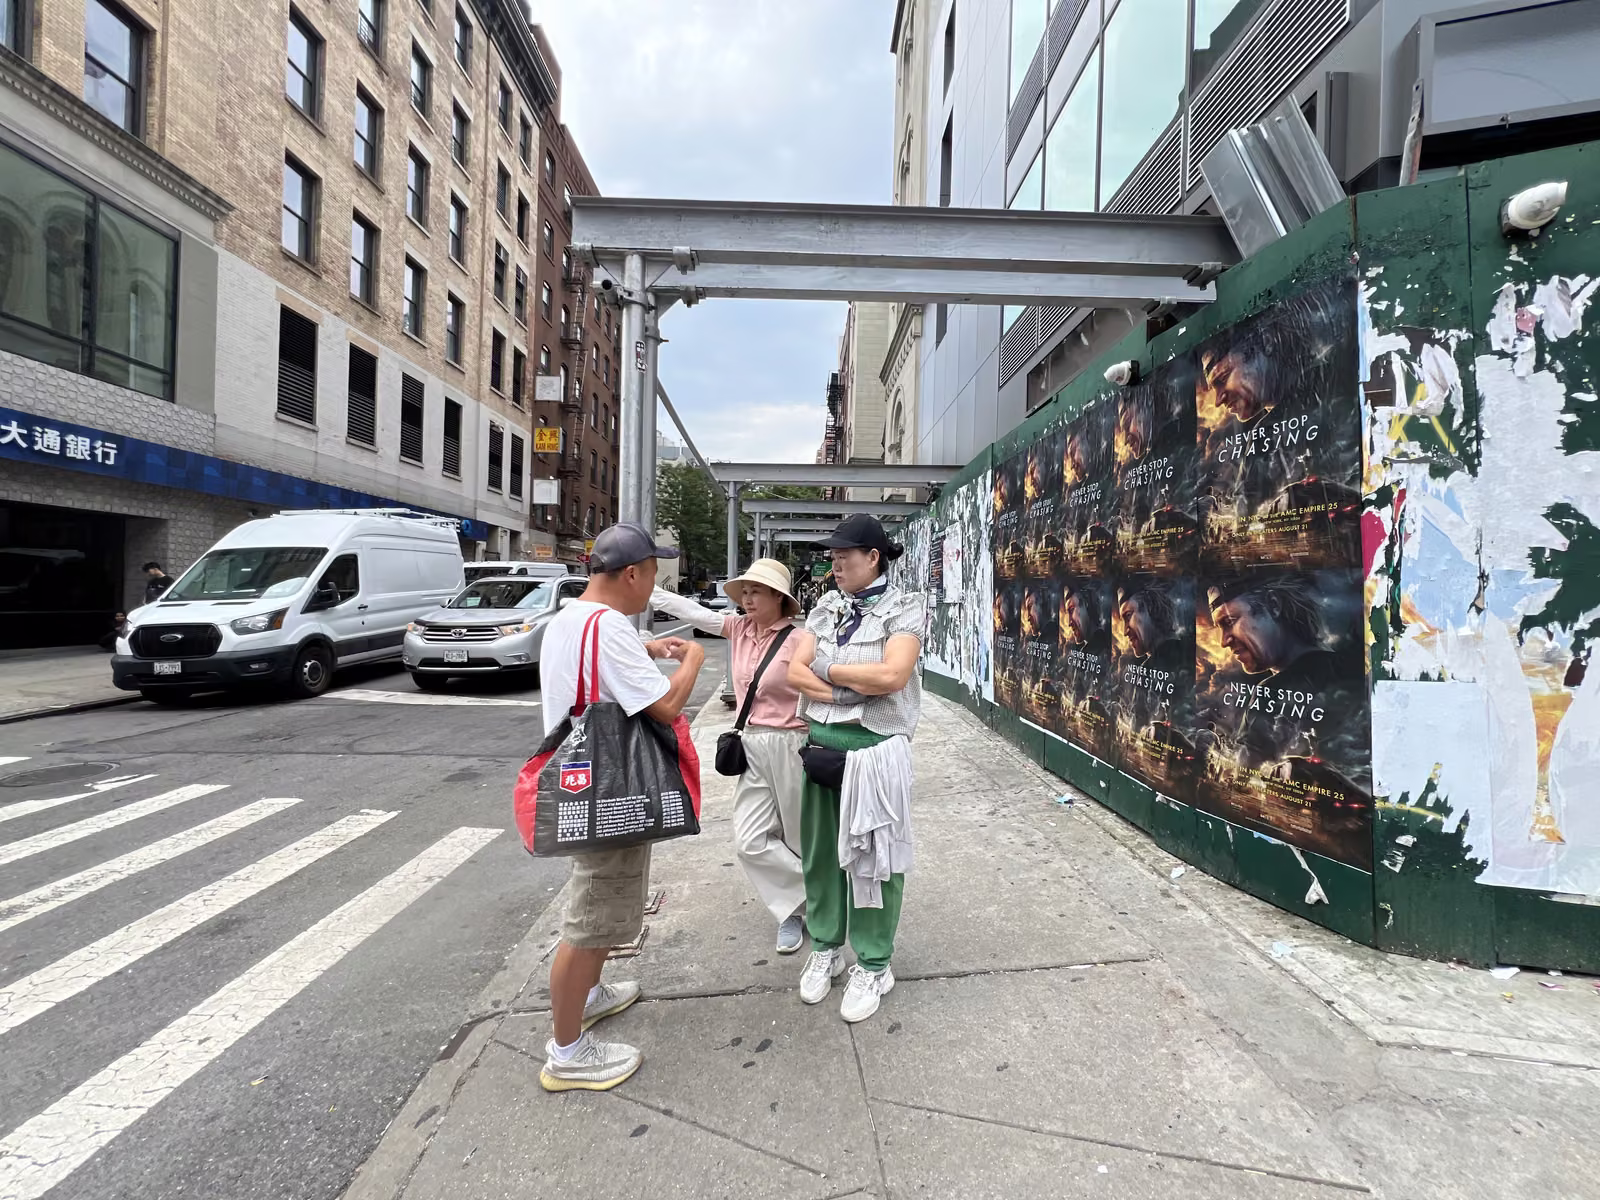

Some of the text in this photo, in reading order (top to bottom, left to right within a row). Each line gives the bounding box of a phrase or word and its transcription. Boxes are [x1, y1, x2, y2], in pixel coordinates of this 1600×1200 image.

[1225, 415, 1308, 447] NEVER STOP
[0, 420, 118, 465] 大通銀行
[1218, 425, 1319, 463] CHASING
[1124, 466, 1174, 490] CHASING
[1128, 457, 1168, 478] NEVER STOP
[1069, 489, 1102, 507] CHASING
[1281, 508, 1297, 517] AMC
[1300, 503, 1326, 514] EMPIRE
[1329, 502, 1338, 510] 25
[1279, 524, 1301, 533] AUGUST
[1067, 656, 1101, 674] CHASING
[1071, 649, 1099, 663] NEVER STOP
[1124, 672, 1175, 694] CHASING
[1127, 664, 1169, 681] NEVER STOP
[1230, 682, 1313, 704] NEVER STOP
[1223, 693, 1325, 722] CHASING
[1280, 792, 1304, 805] AUGUST
[1304, 800, 1312, 808] 21
[1283, 779, 1301, 789] AMC
[1303, 783, 1331, 797] EMPIRE
[1333, 792, 1345, 801] 25
